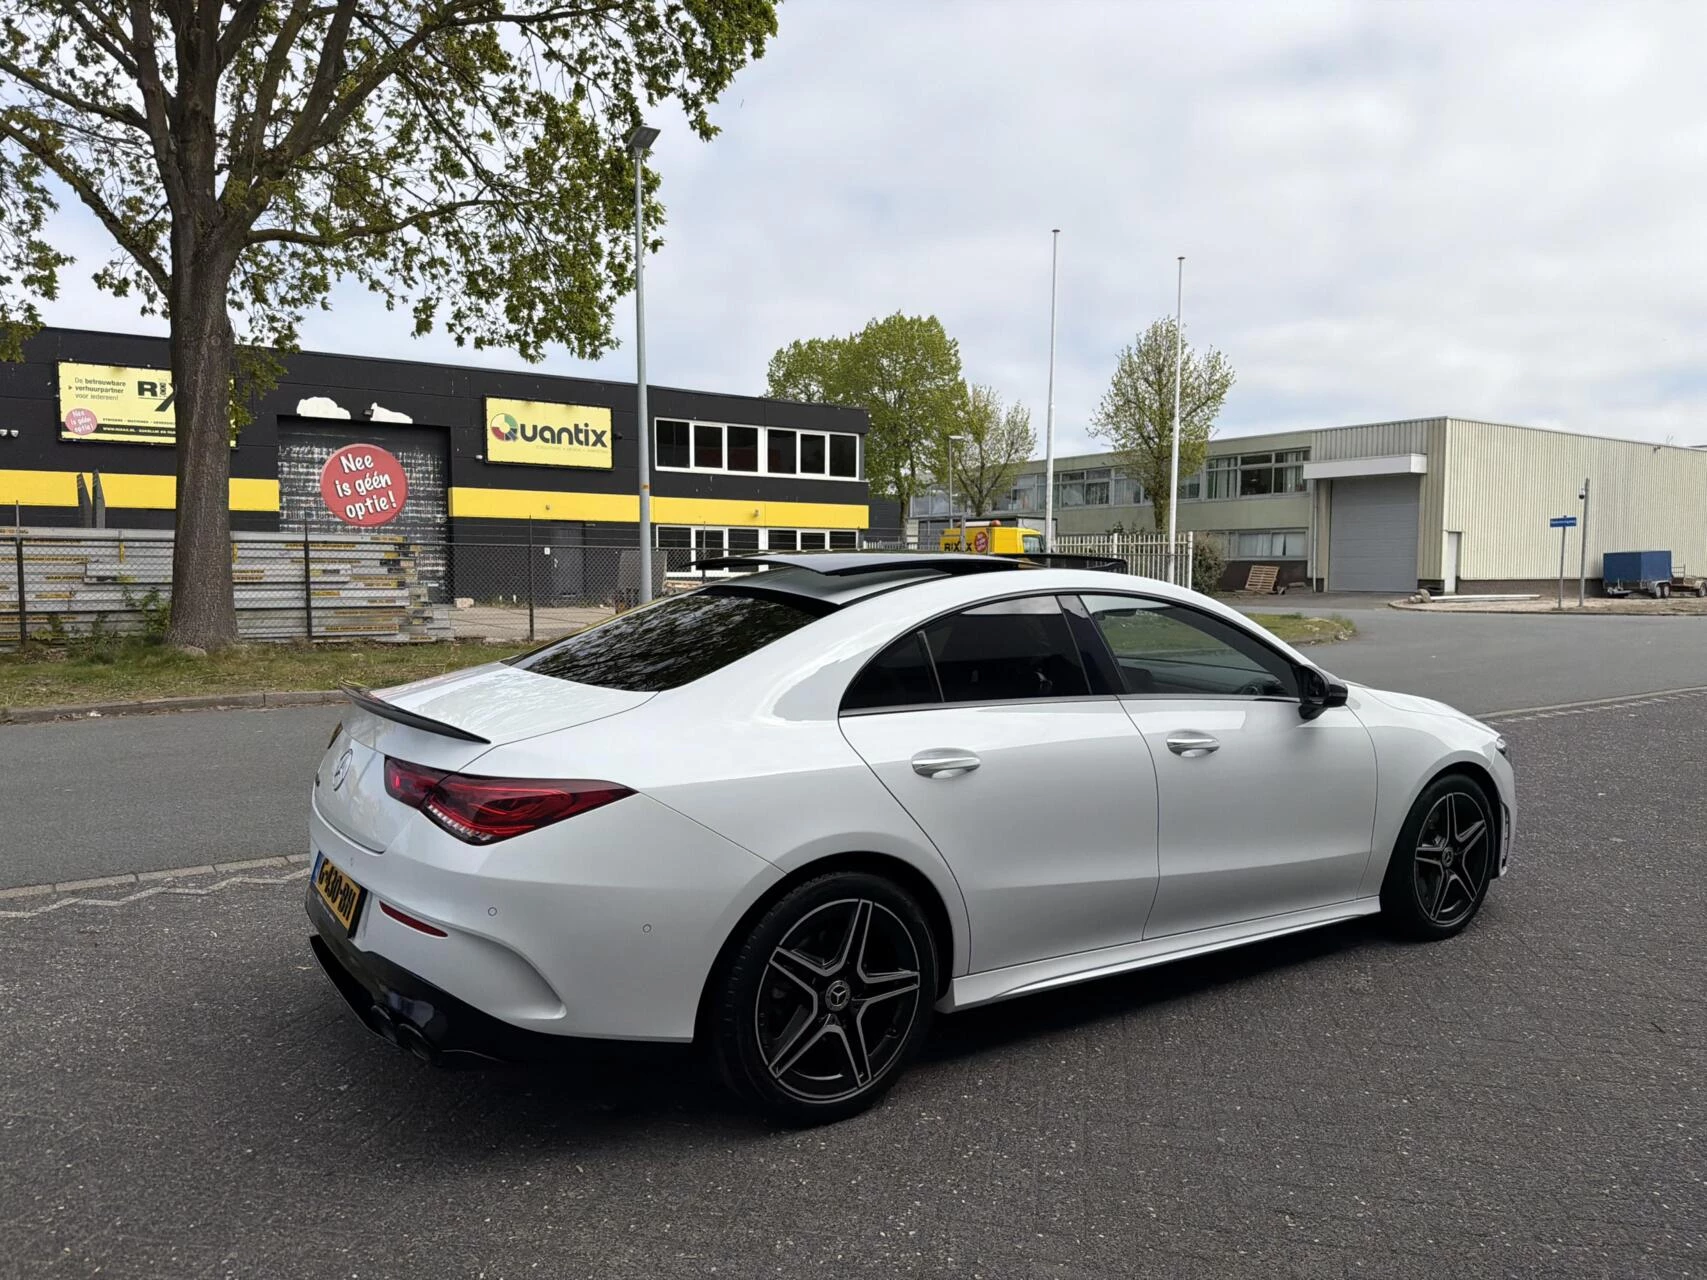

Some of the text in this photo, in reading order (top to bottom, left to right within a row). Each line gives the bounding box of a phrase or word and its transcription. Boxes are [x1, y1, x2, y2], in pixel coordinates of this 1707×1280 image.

[75, 385, 124, 394] verhuurpartner
[84, 378, 126, 386] betrouwbare
[490, 413, 608, 448] Quantix
[340, 453, 374, 474] Nee
[334, 471, 392, 498] is géén
[345, 490, 397, 520] optie!
